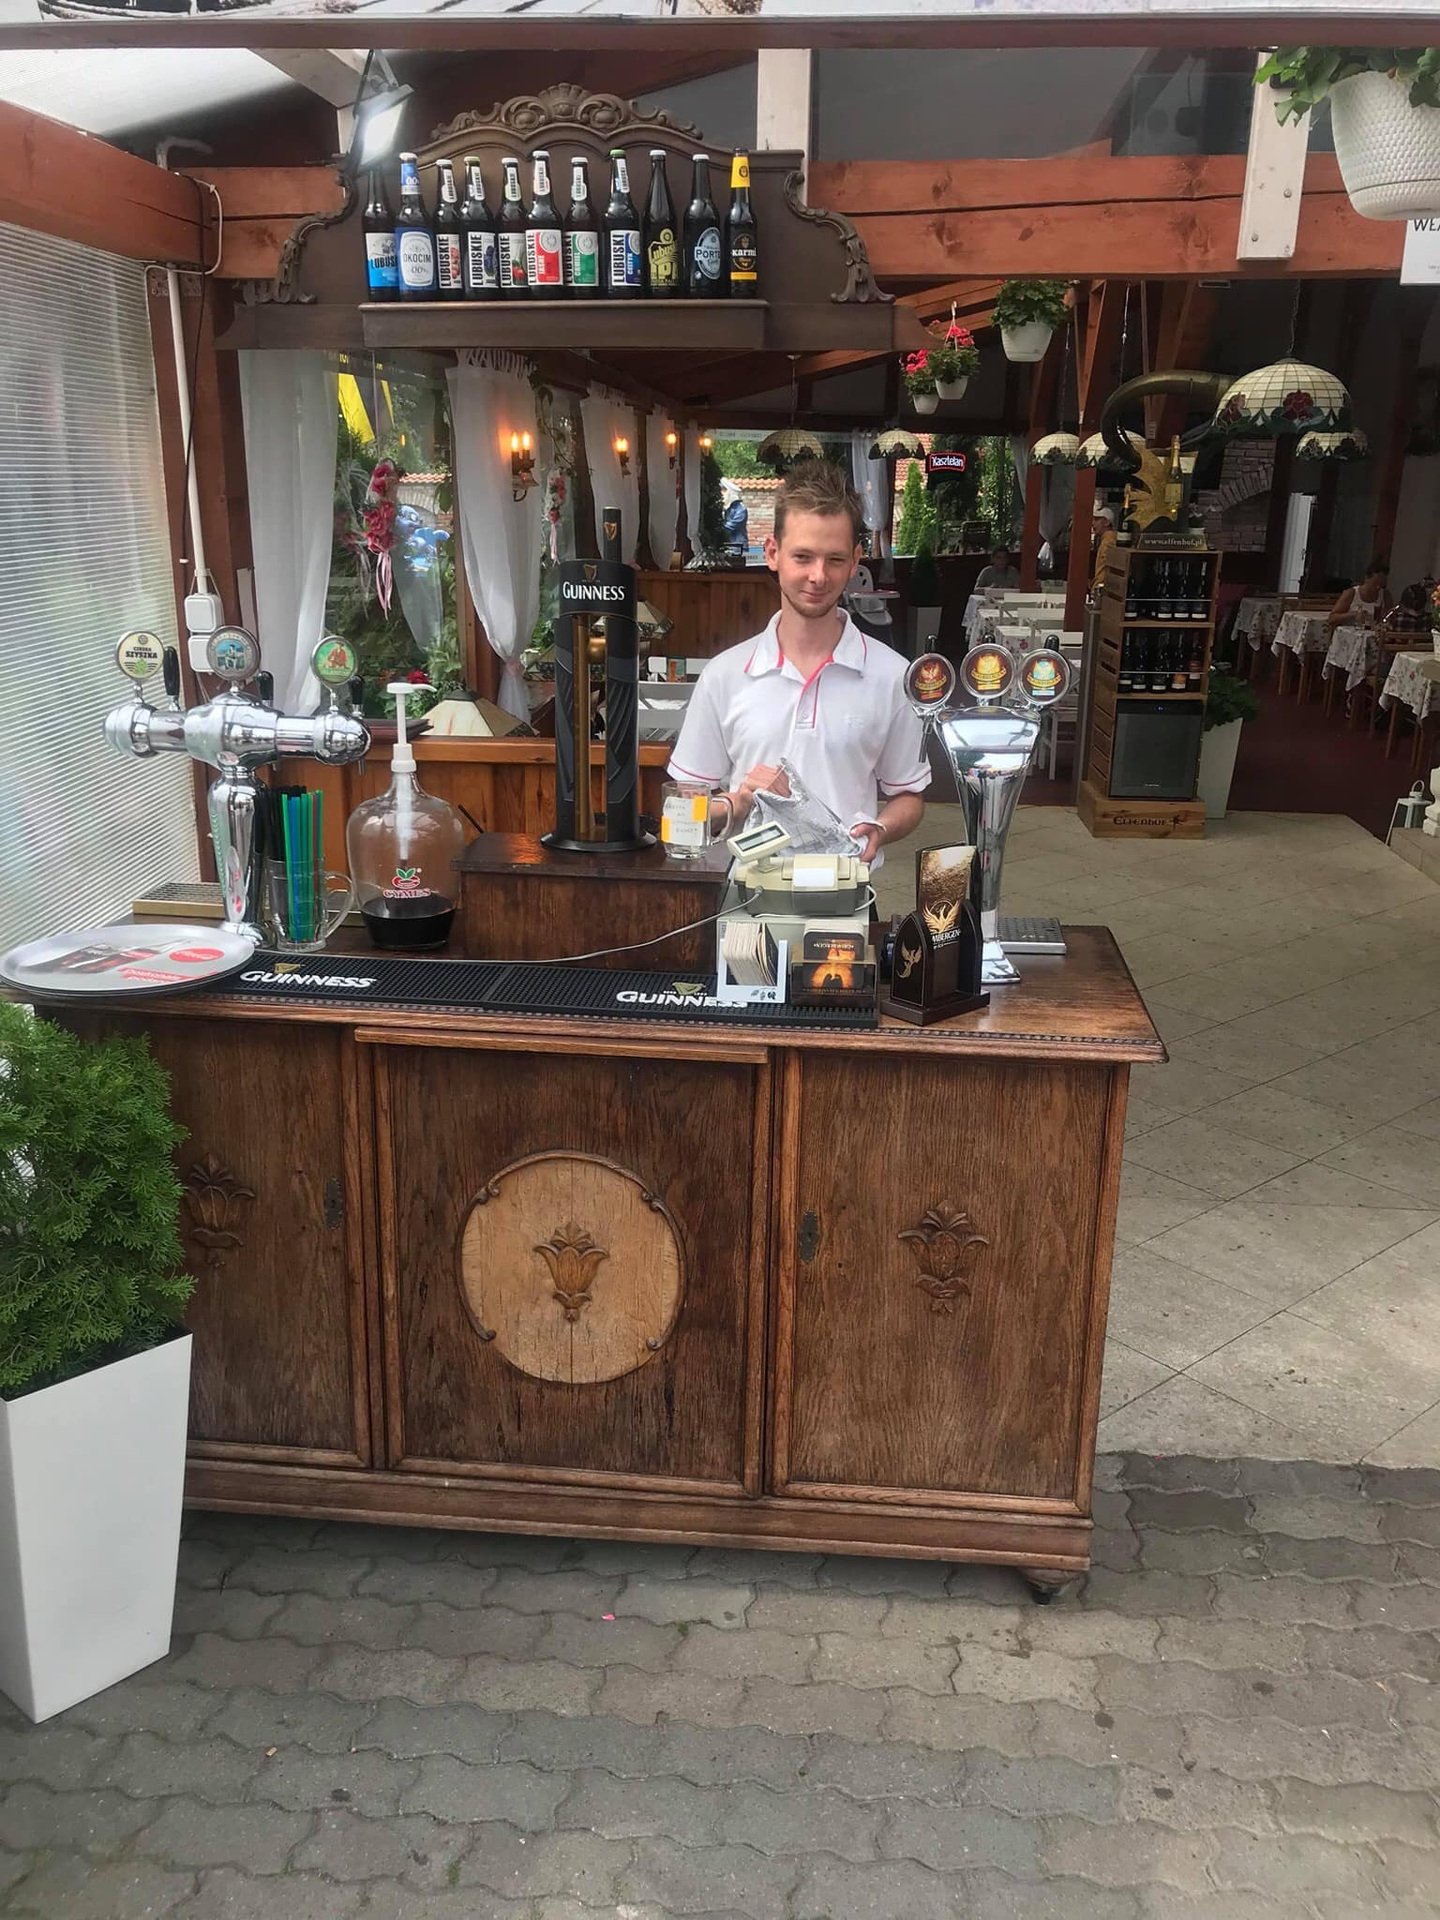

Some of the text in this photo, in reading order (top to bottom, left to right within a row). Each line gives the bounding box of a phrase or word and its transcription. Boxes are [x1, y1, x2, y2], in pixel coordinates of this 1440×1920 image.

[403, 253, 432, 263] OKOCIM
[438, 236, 451, 286] LUBUSKIE
[471, 235, 483, 286] LUBUSKIE
[500, 235, 512, 286] LUBUSKIE
[527, 232, 537, 284] LUBUSKIE
[613, 235, 625, 283] LUBUSKI
[563, 581, 625, 601] GUINNESS
[240, 970, 377, 988] GUINNESS
